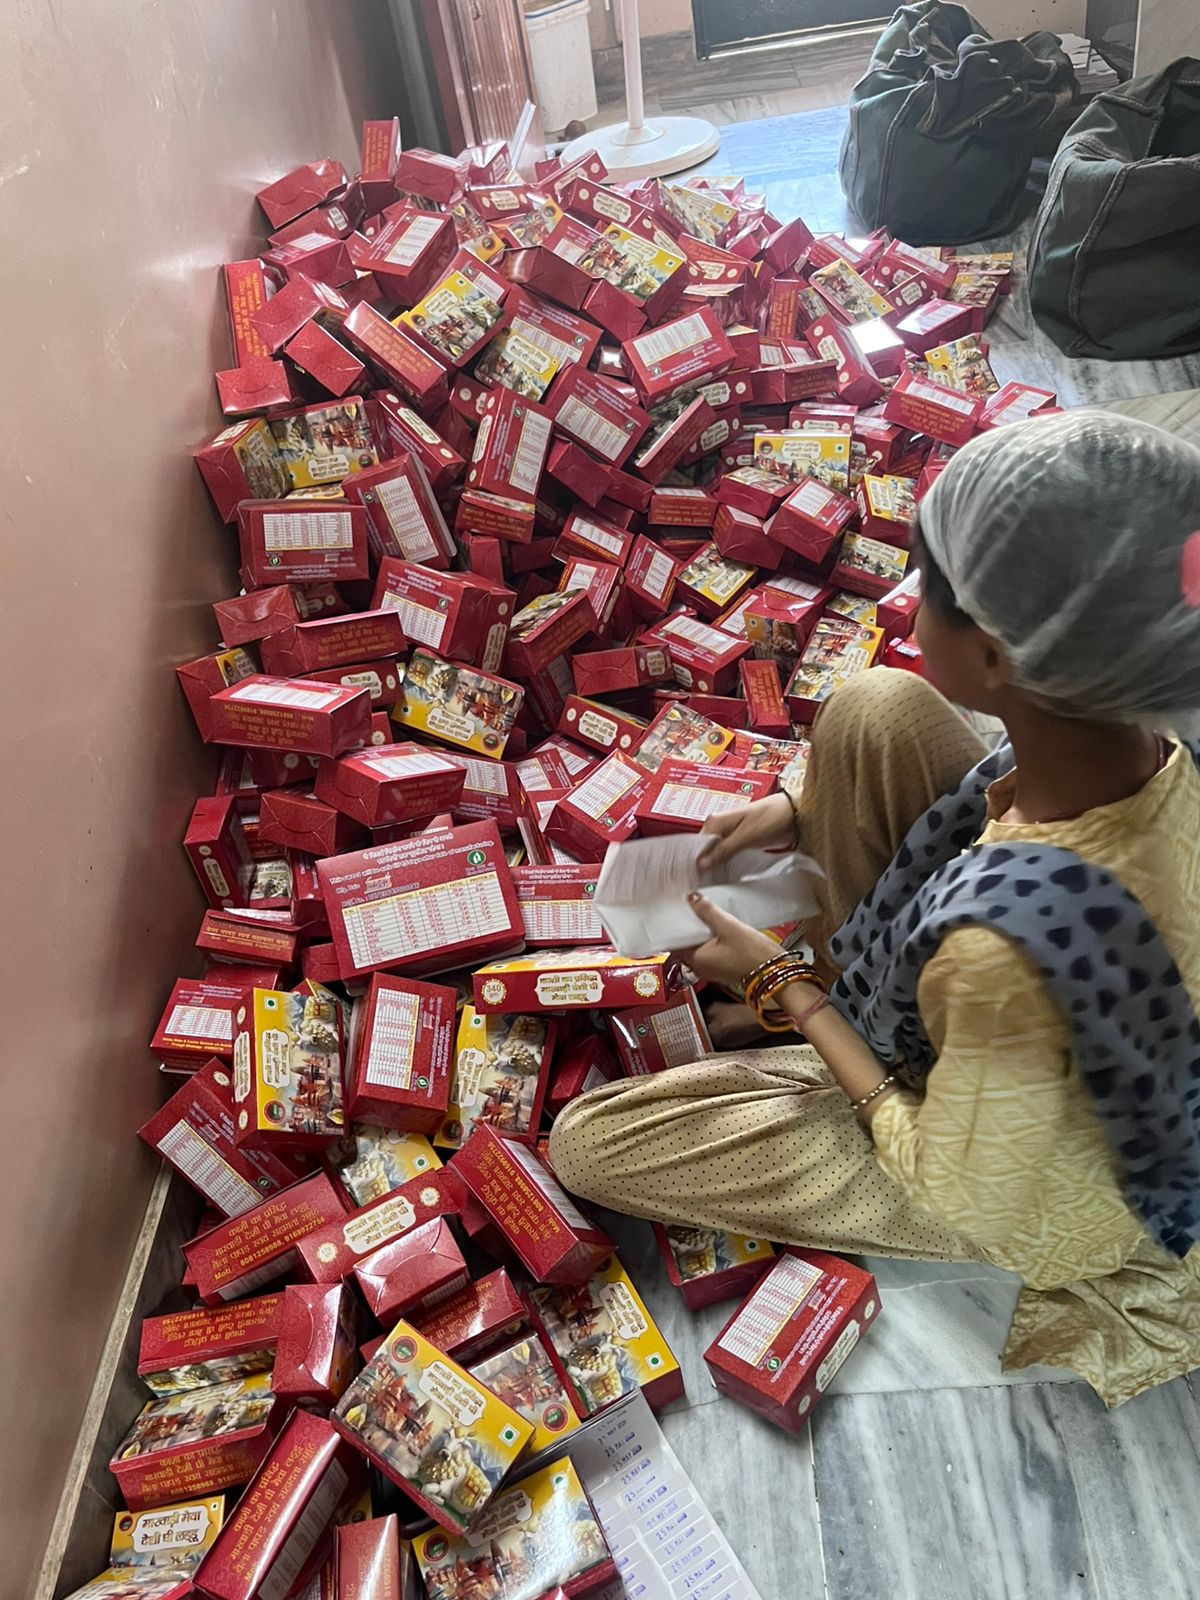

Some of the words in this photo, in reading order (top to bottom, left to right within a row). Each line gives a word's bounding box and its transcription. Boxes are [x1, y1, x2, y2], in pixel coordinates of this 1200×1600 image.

[486, 984, 500, 992] 340
[487, 1177, 502, 1193] मेवा
[492, 1165, 514, 1190] सहायता
[477, 1183, 499, 1206] प्रसिद्ध
[226, 1219, 249, 1237] काशी
[249, 1214, 262, 1225] का
[262, 1199, 287, 1218] प्रसिद्ध
[496, 1204, 507, 1215] का
[504, 1201, 521, 1218] देशी
[503, 1214, 522, 1235] काशी
[223, 1329, 245, 1339] काशी
[277, 1465, 301, 1499] सहायता
[230, 1505, 252, 1532] काशी
[248, 1490, 261, 1505] का
[256, 1459, 280, 1490] प्रसिद्ध
[249, 1501, 267, 1523] देशी
[270, 1467, 287, 1487] मेवा
[180, 1509, 201, 1522] मेवा
[140, 1532, 160, 1545] देशी
[162, 1529, 173, 1542] घी
